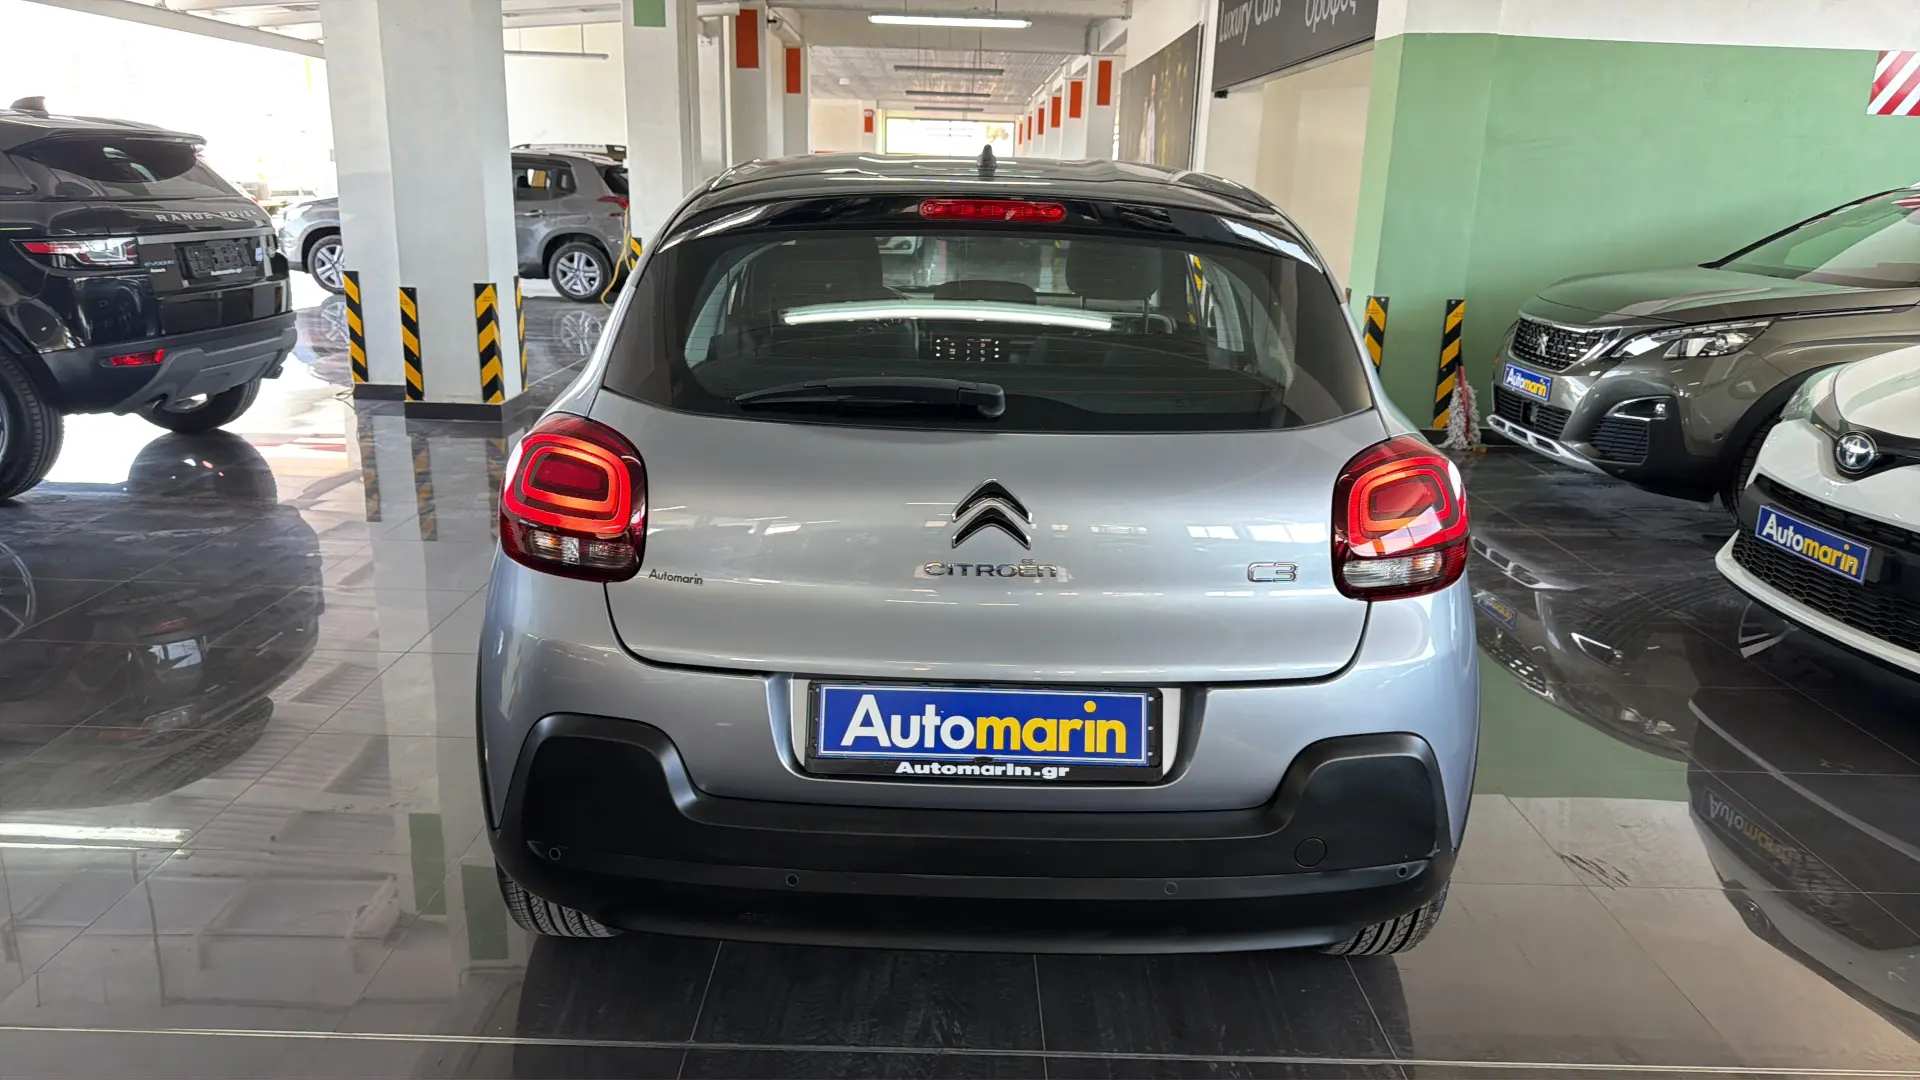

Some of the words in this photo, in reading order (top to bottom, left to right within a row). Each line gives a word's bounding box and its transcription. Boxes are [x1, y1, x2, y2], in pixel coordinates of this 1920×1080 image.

[1219, 0, 1253, 46] Luxury
[155, 211, 213, 222] RANGE
[219, 209, 259, 219] ROVER
[1506, 367, 1547, 397] Automarin
[1762, 513, 1859, 576] Automarin
[648, 568, 703, 585] Automarin
[1247, 561, 1298, 582] C3
[840, 694, 1127, 754] Automarin
[895, 761, 1070, 779] Automarin.gr
